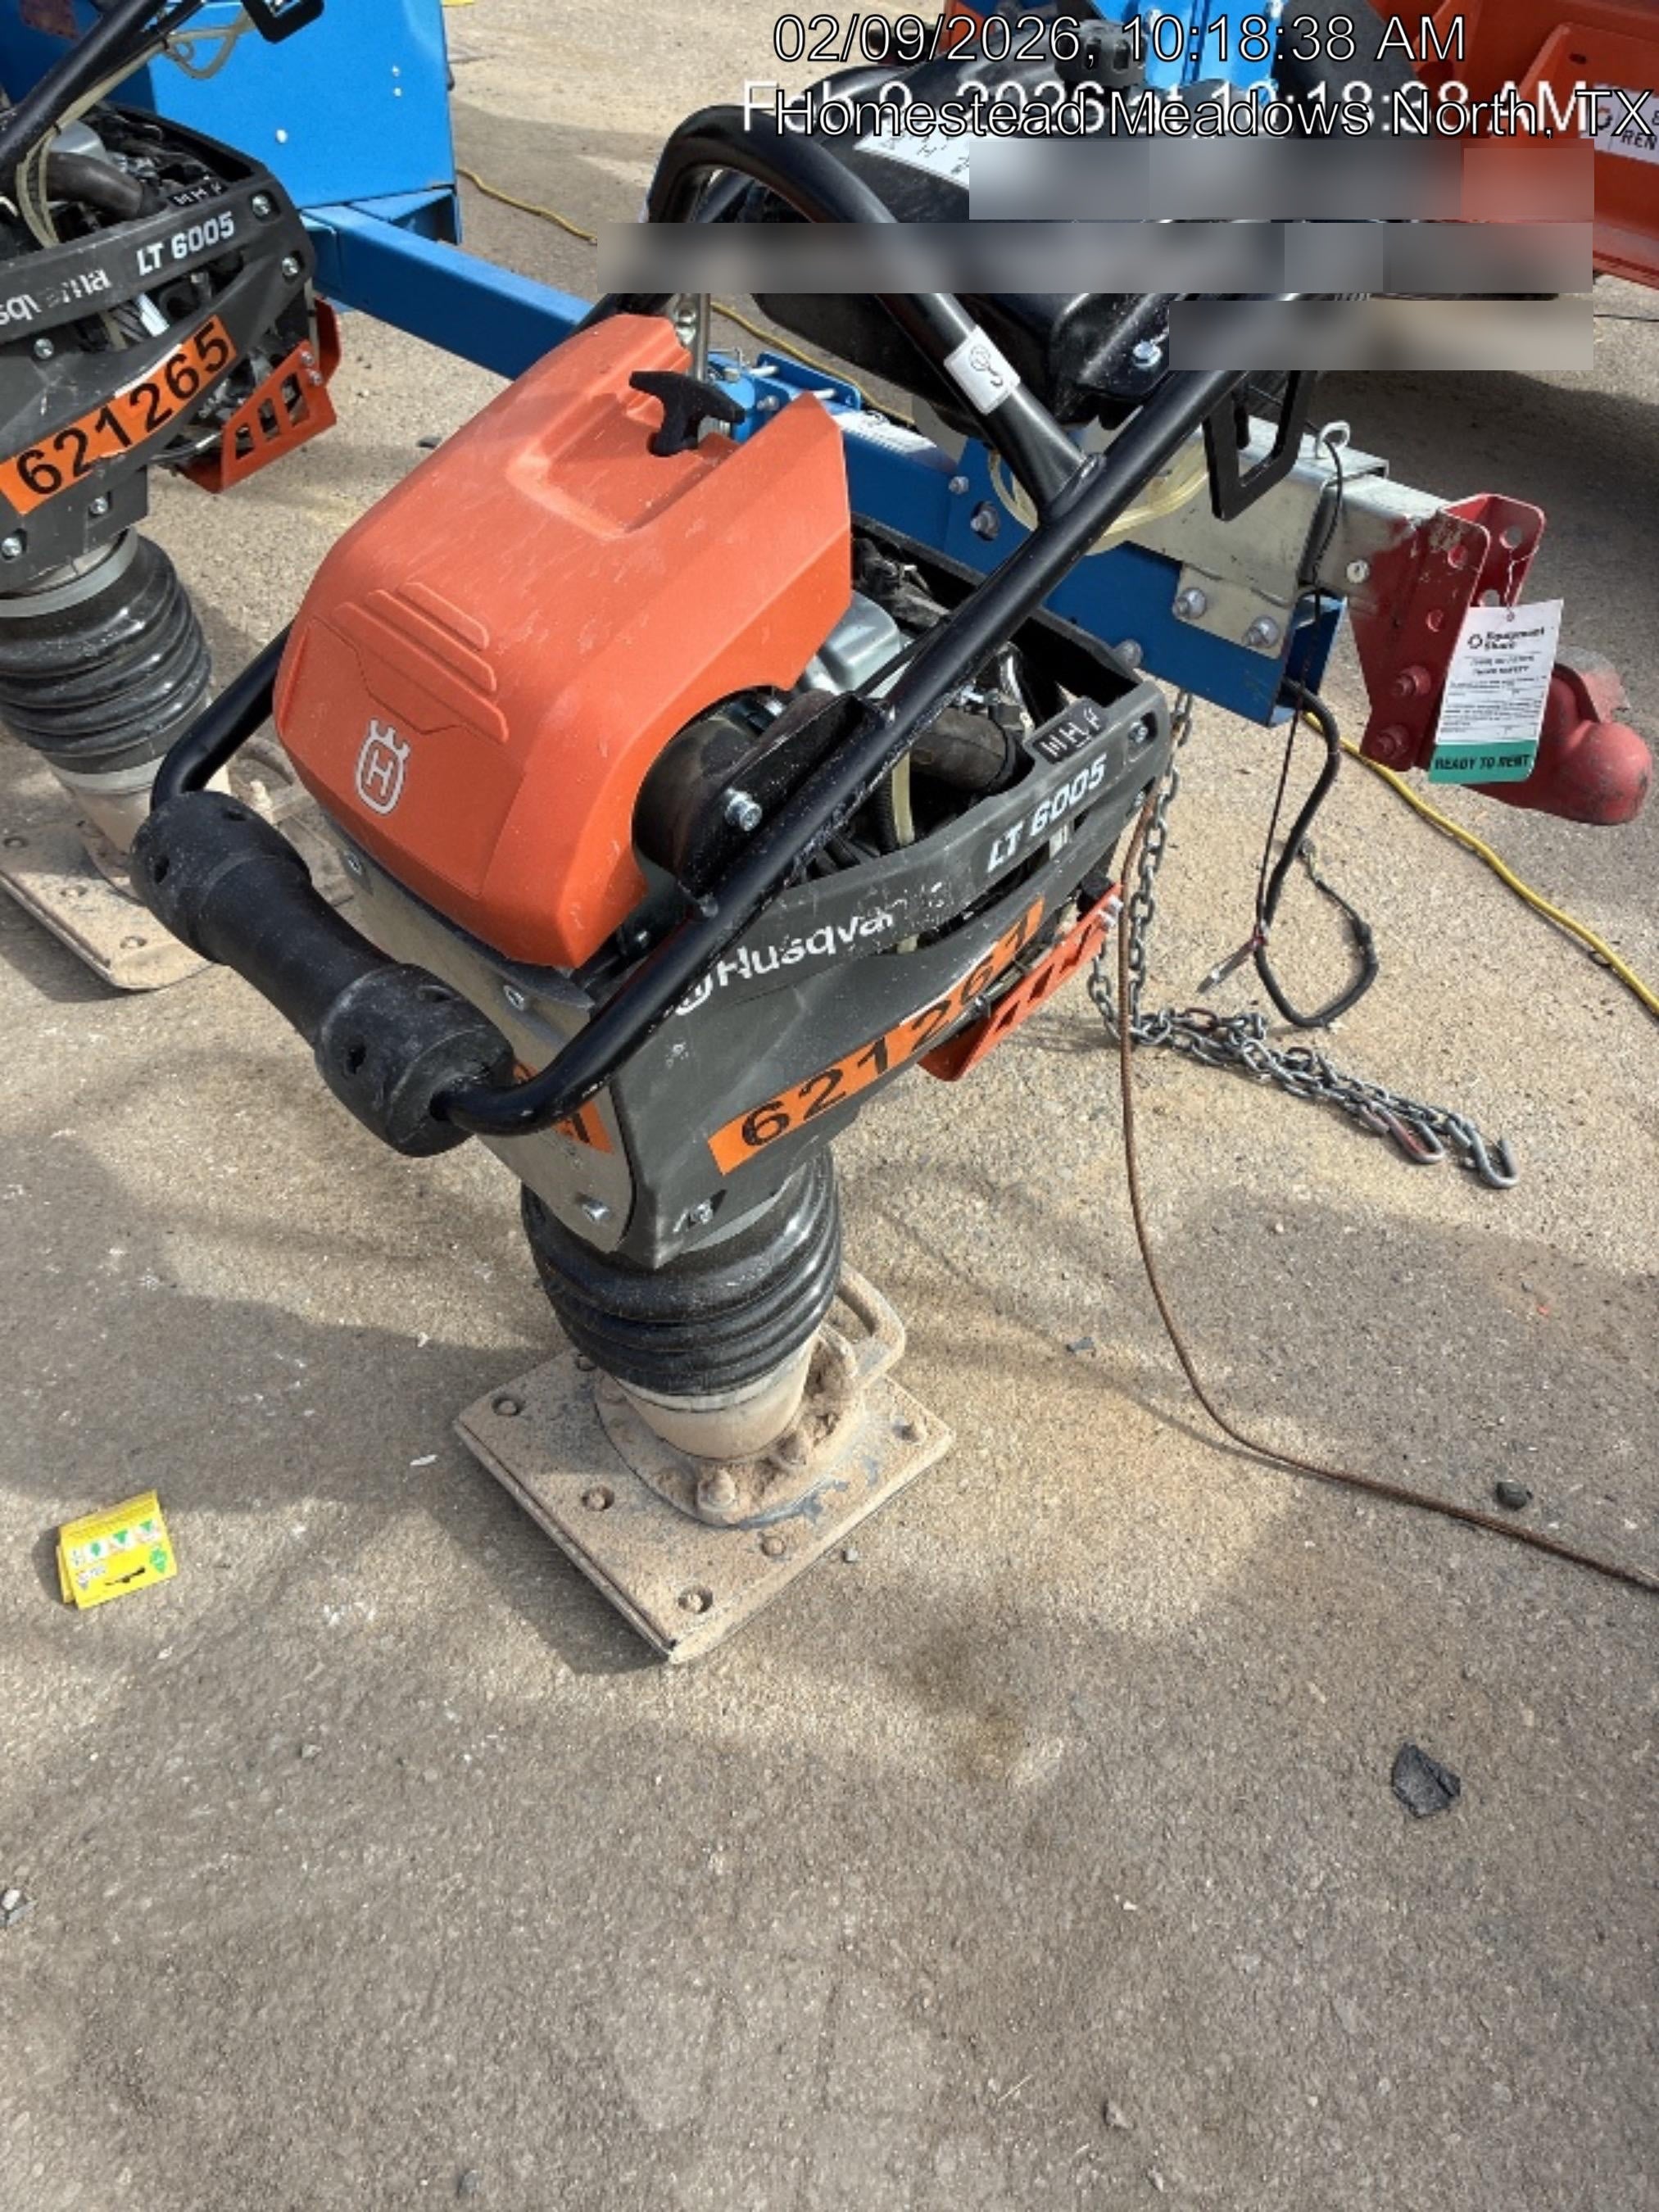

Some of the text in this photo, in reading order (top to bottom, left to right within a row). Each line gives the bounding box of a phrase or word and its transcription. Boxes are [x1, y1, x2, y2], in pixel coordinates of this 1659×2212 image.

[136, 211, 235, 276] LT 6005
[16, 323, 229, 495] 621265
[1435, 754, 1531, 770] READY TO RENT
[987, 753, 1108, 873] LT 6005
